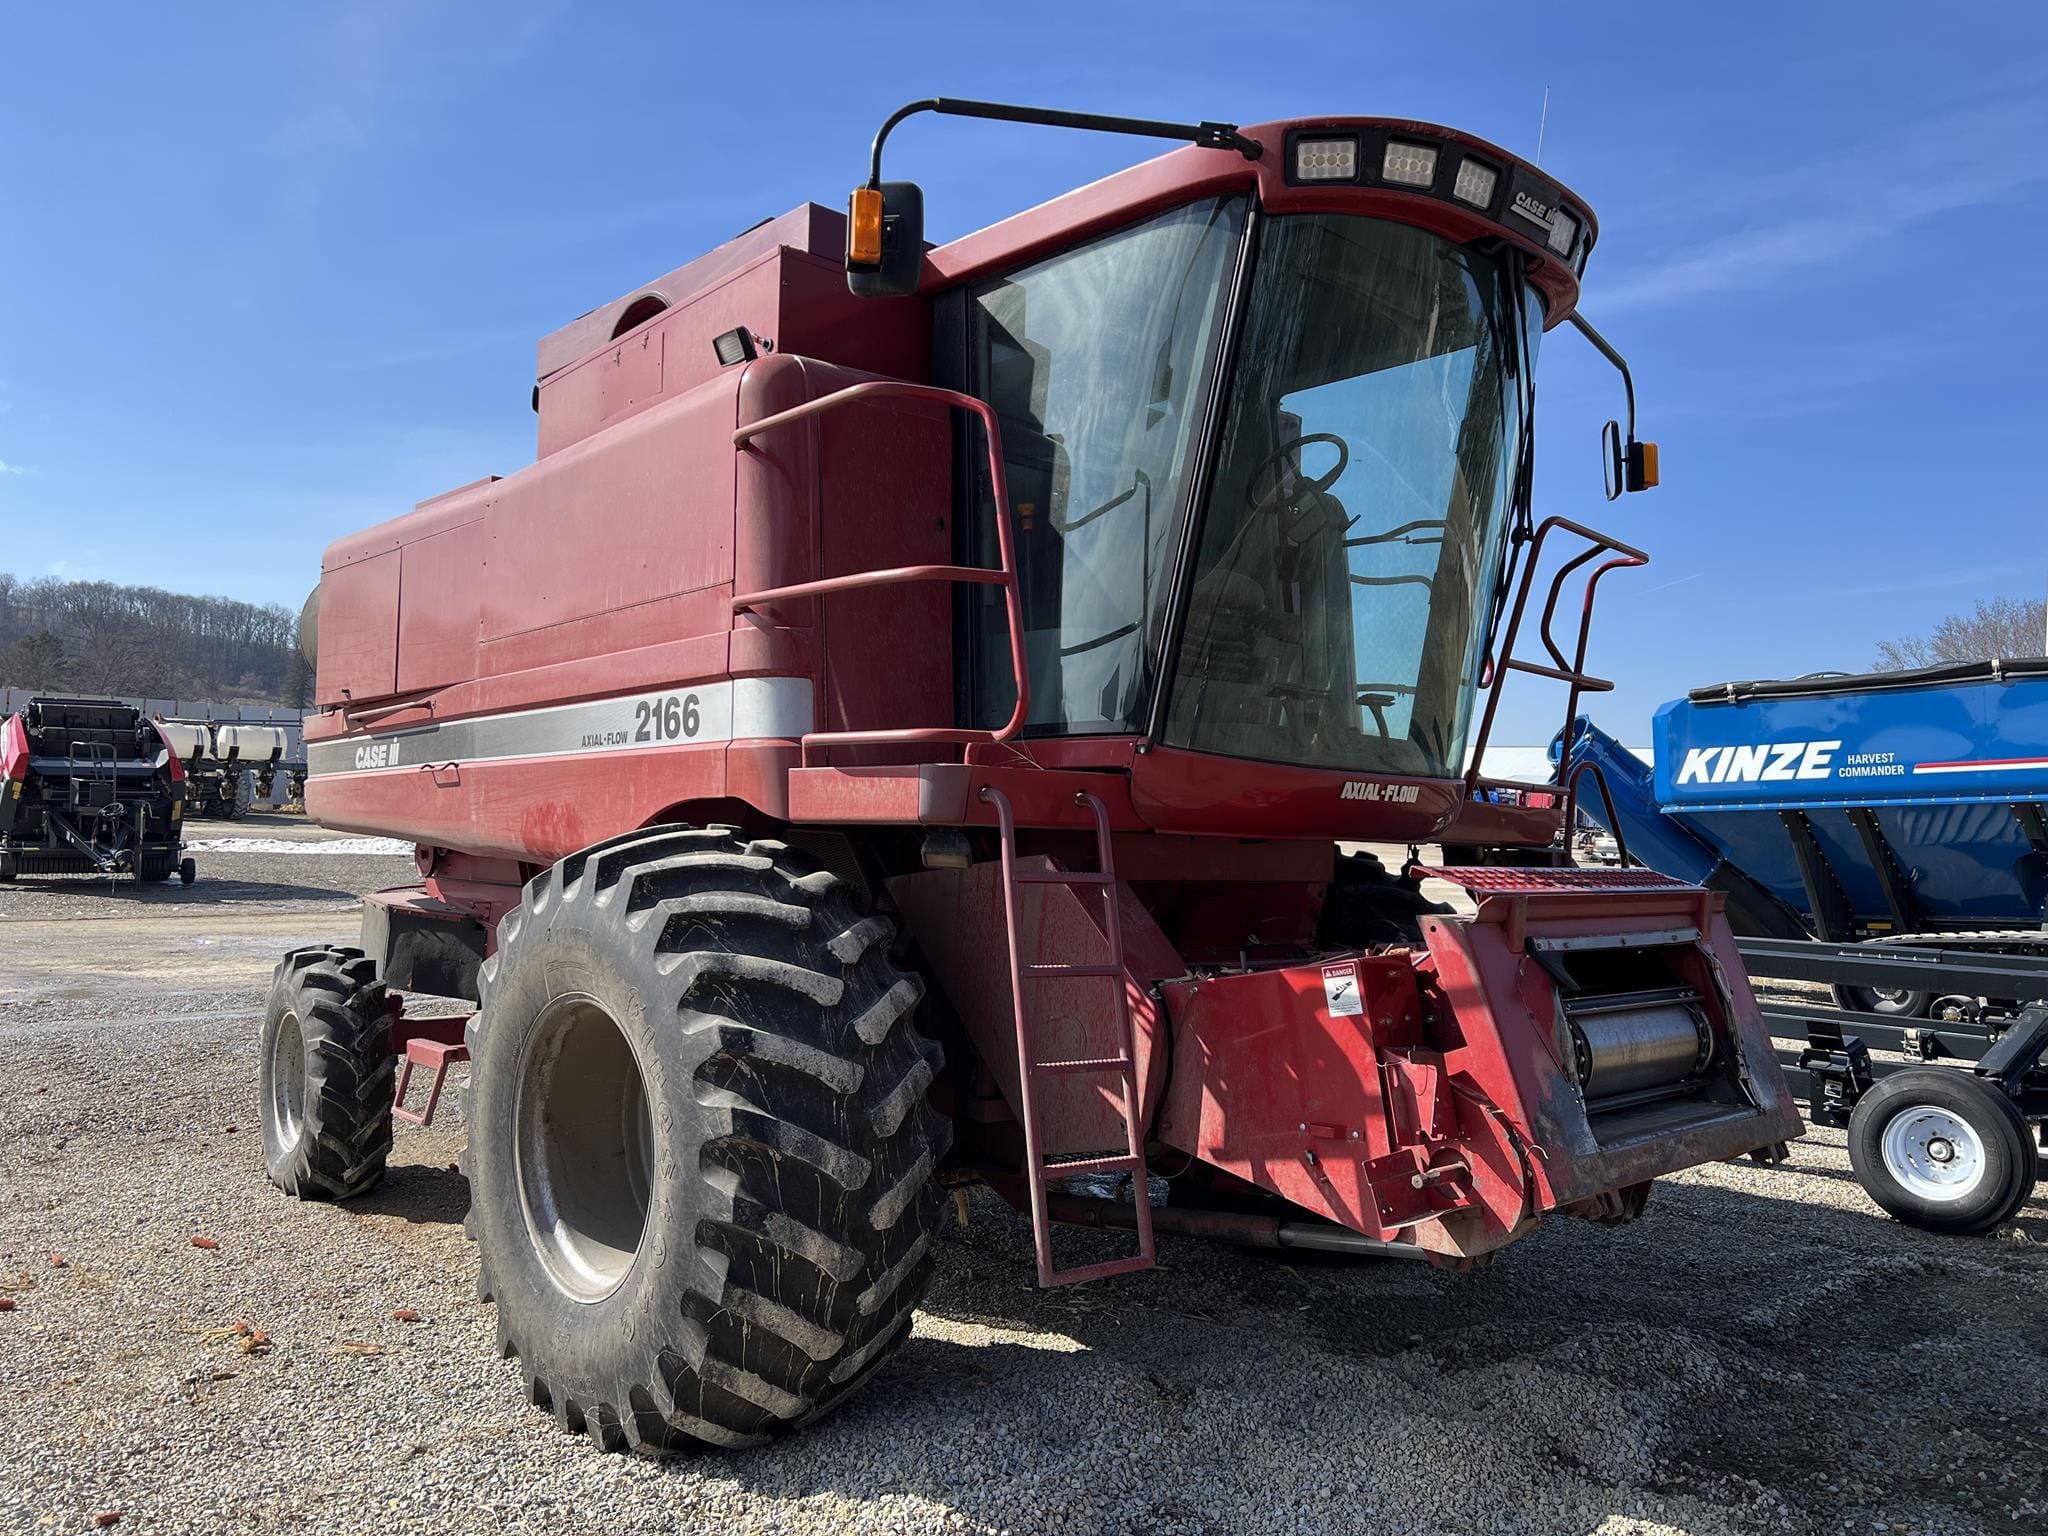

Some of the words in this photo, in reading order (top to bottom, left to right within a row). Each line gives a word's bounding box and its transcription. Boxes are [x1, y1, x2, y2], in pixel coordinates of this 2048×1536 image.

[1515, 192, 1547, 218] CASE
[635, 693, 700, 742] 2166
[355, 744, 388, 769] CASE
[1676, 740, 1841, 784] KINZE
[1847, 752, 1895, 765] HARVEST
[1838, 764, 1905, 778] COMMANDER
[1331, 968, 1353, 977] DANGER
